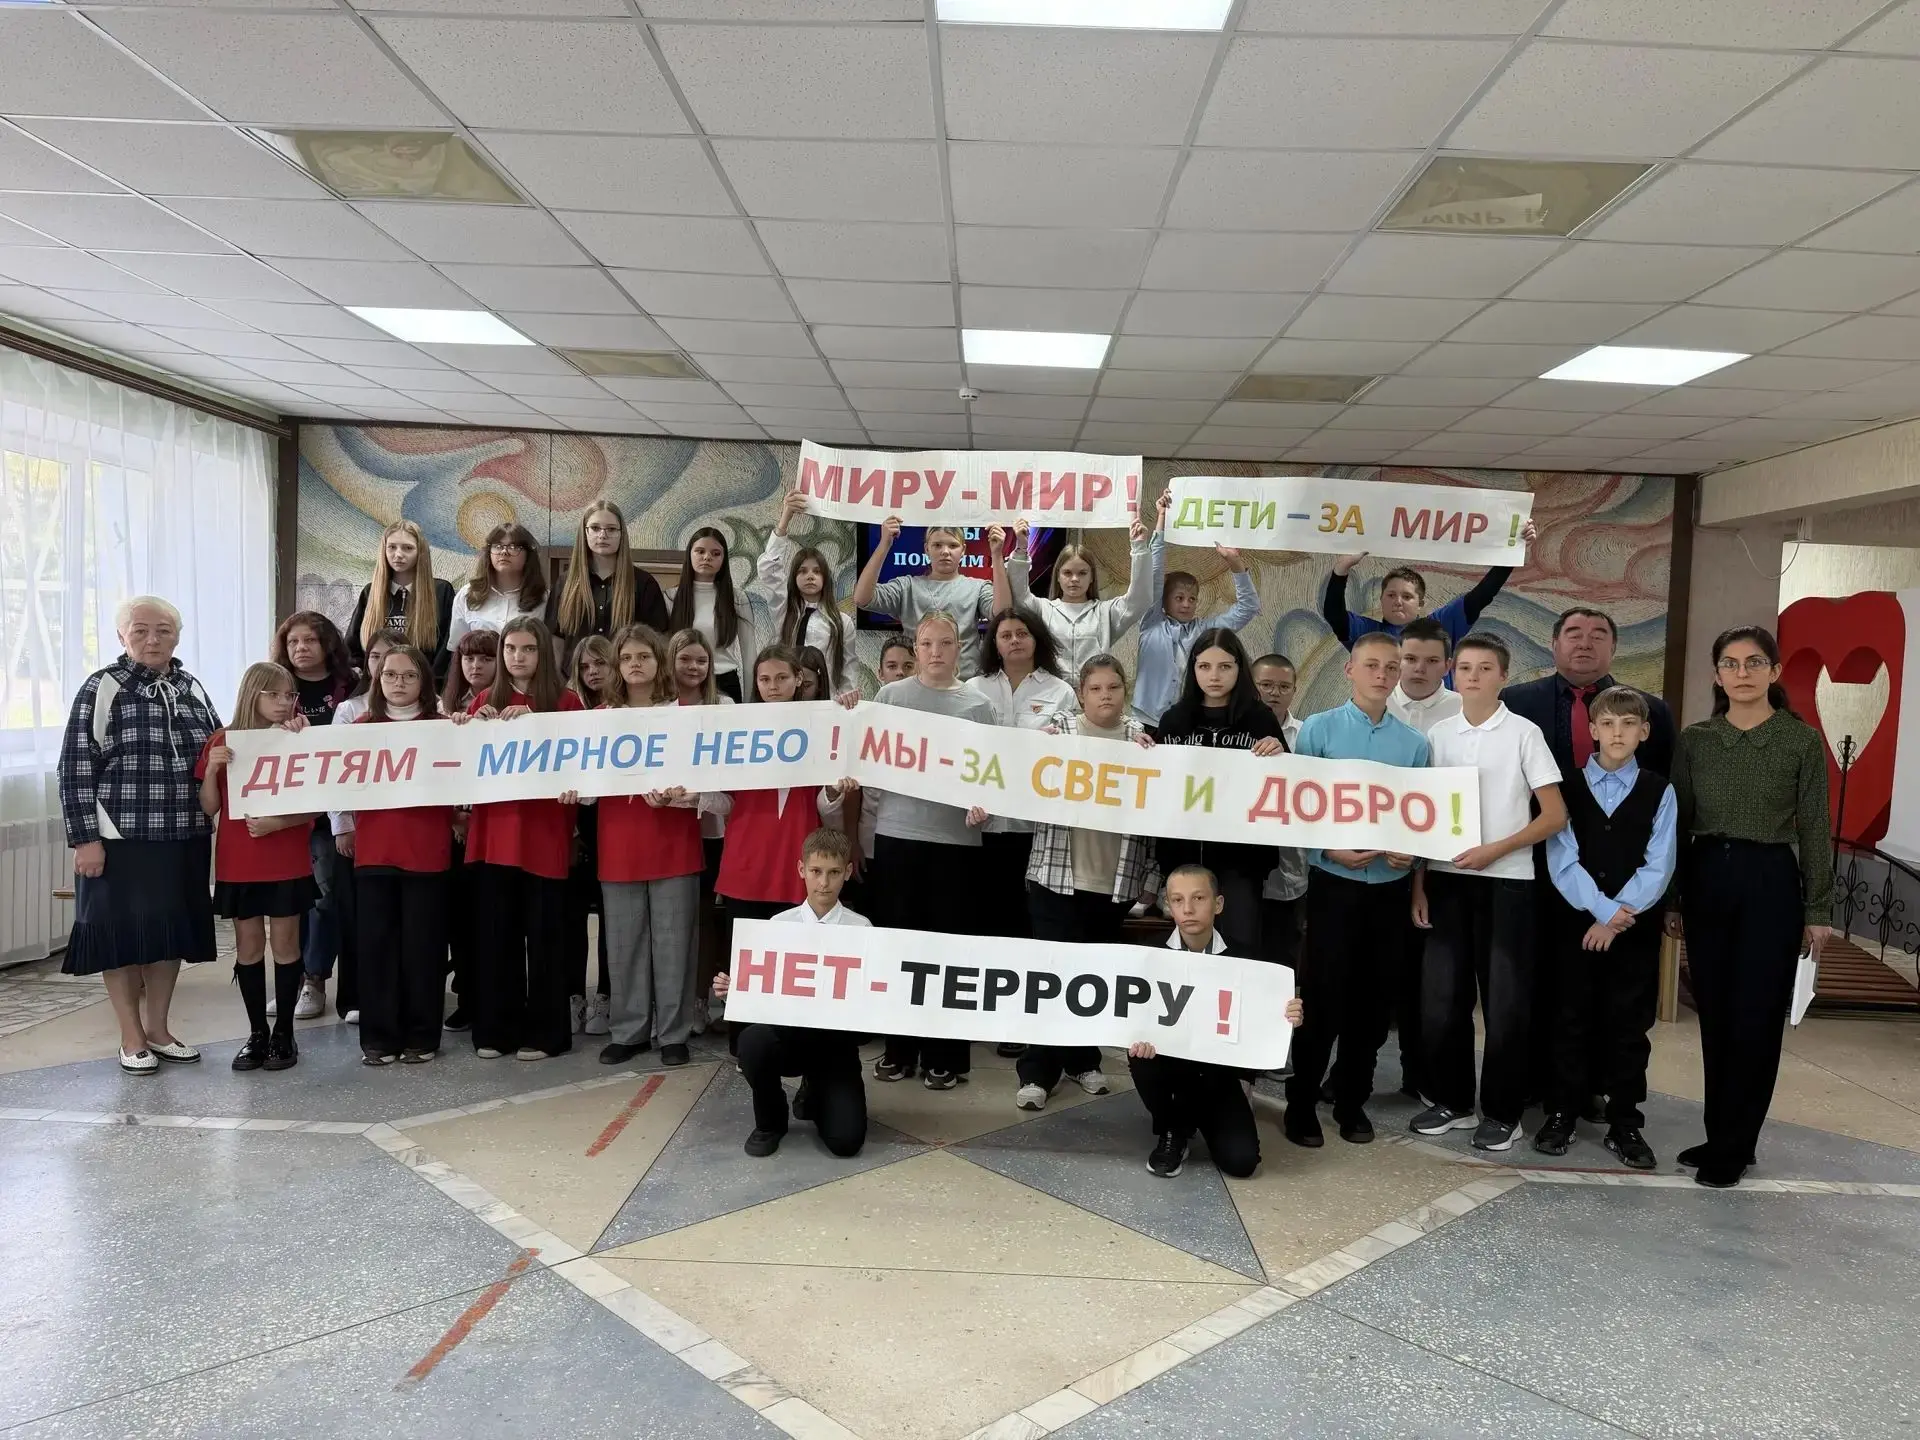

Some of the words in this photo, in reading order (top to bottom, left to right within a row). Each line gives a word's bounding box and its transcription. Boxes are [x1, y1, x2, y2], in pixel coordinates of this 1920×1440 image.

[963, 527, 980, 540] Ы
[1173, 497, 1276, 530] ДЕТИ
[1318, 503, 1365, 536] ЗА
[1390, 506, 1488, 543] МИР
[241, 747, 418, 797] ДЕТЯМ
[477, 732, 668, 777] МИРНОЕ
[691, 728, 809, 766] НЕБО
[859, 726, 928, 772] МЫ
[1030, 755, 1161, 810] СВЕТ
[1182, 775, 1215, 813] И
[735, 949, 863, 1000] НЕТ
[900, 960, 1195, 1027] ТЕРРОРУ
